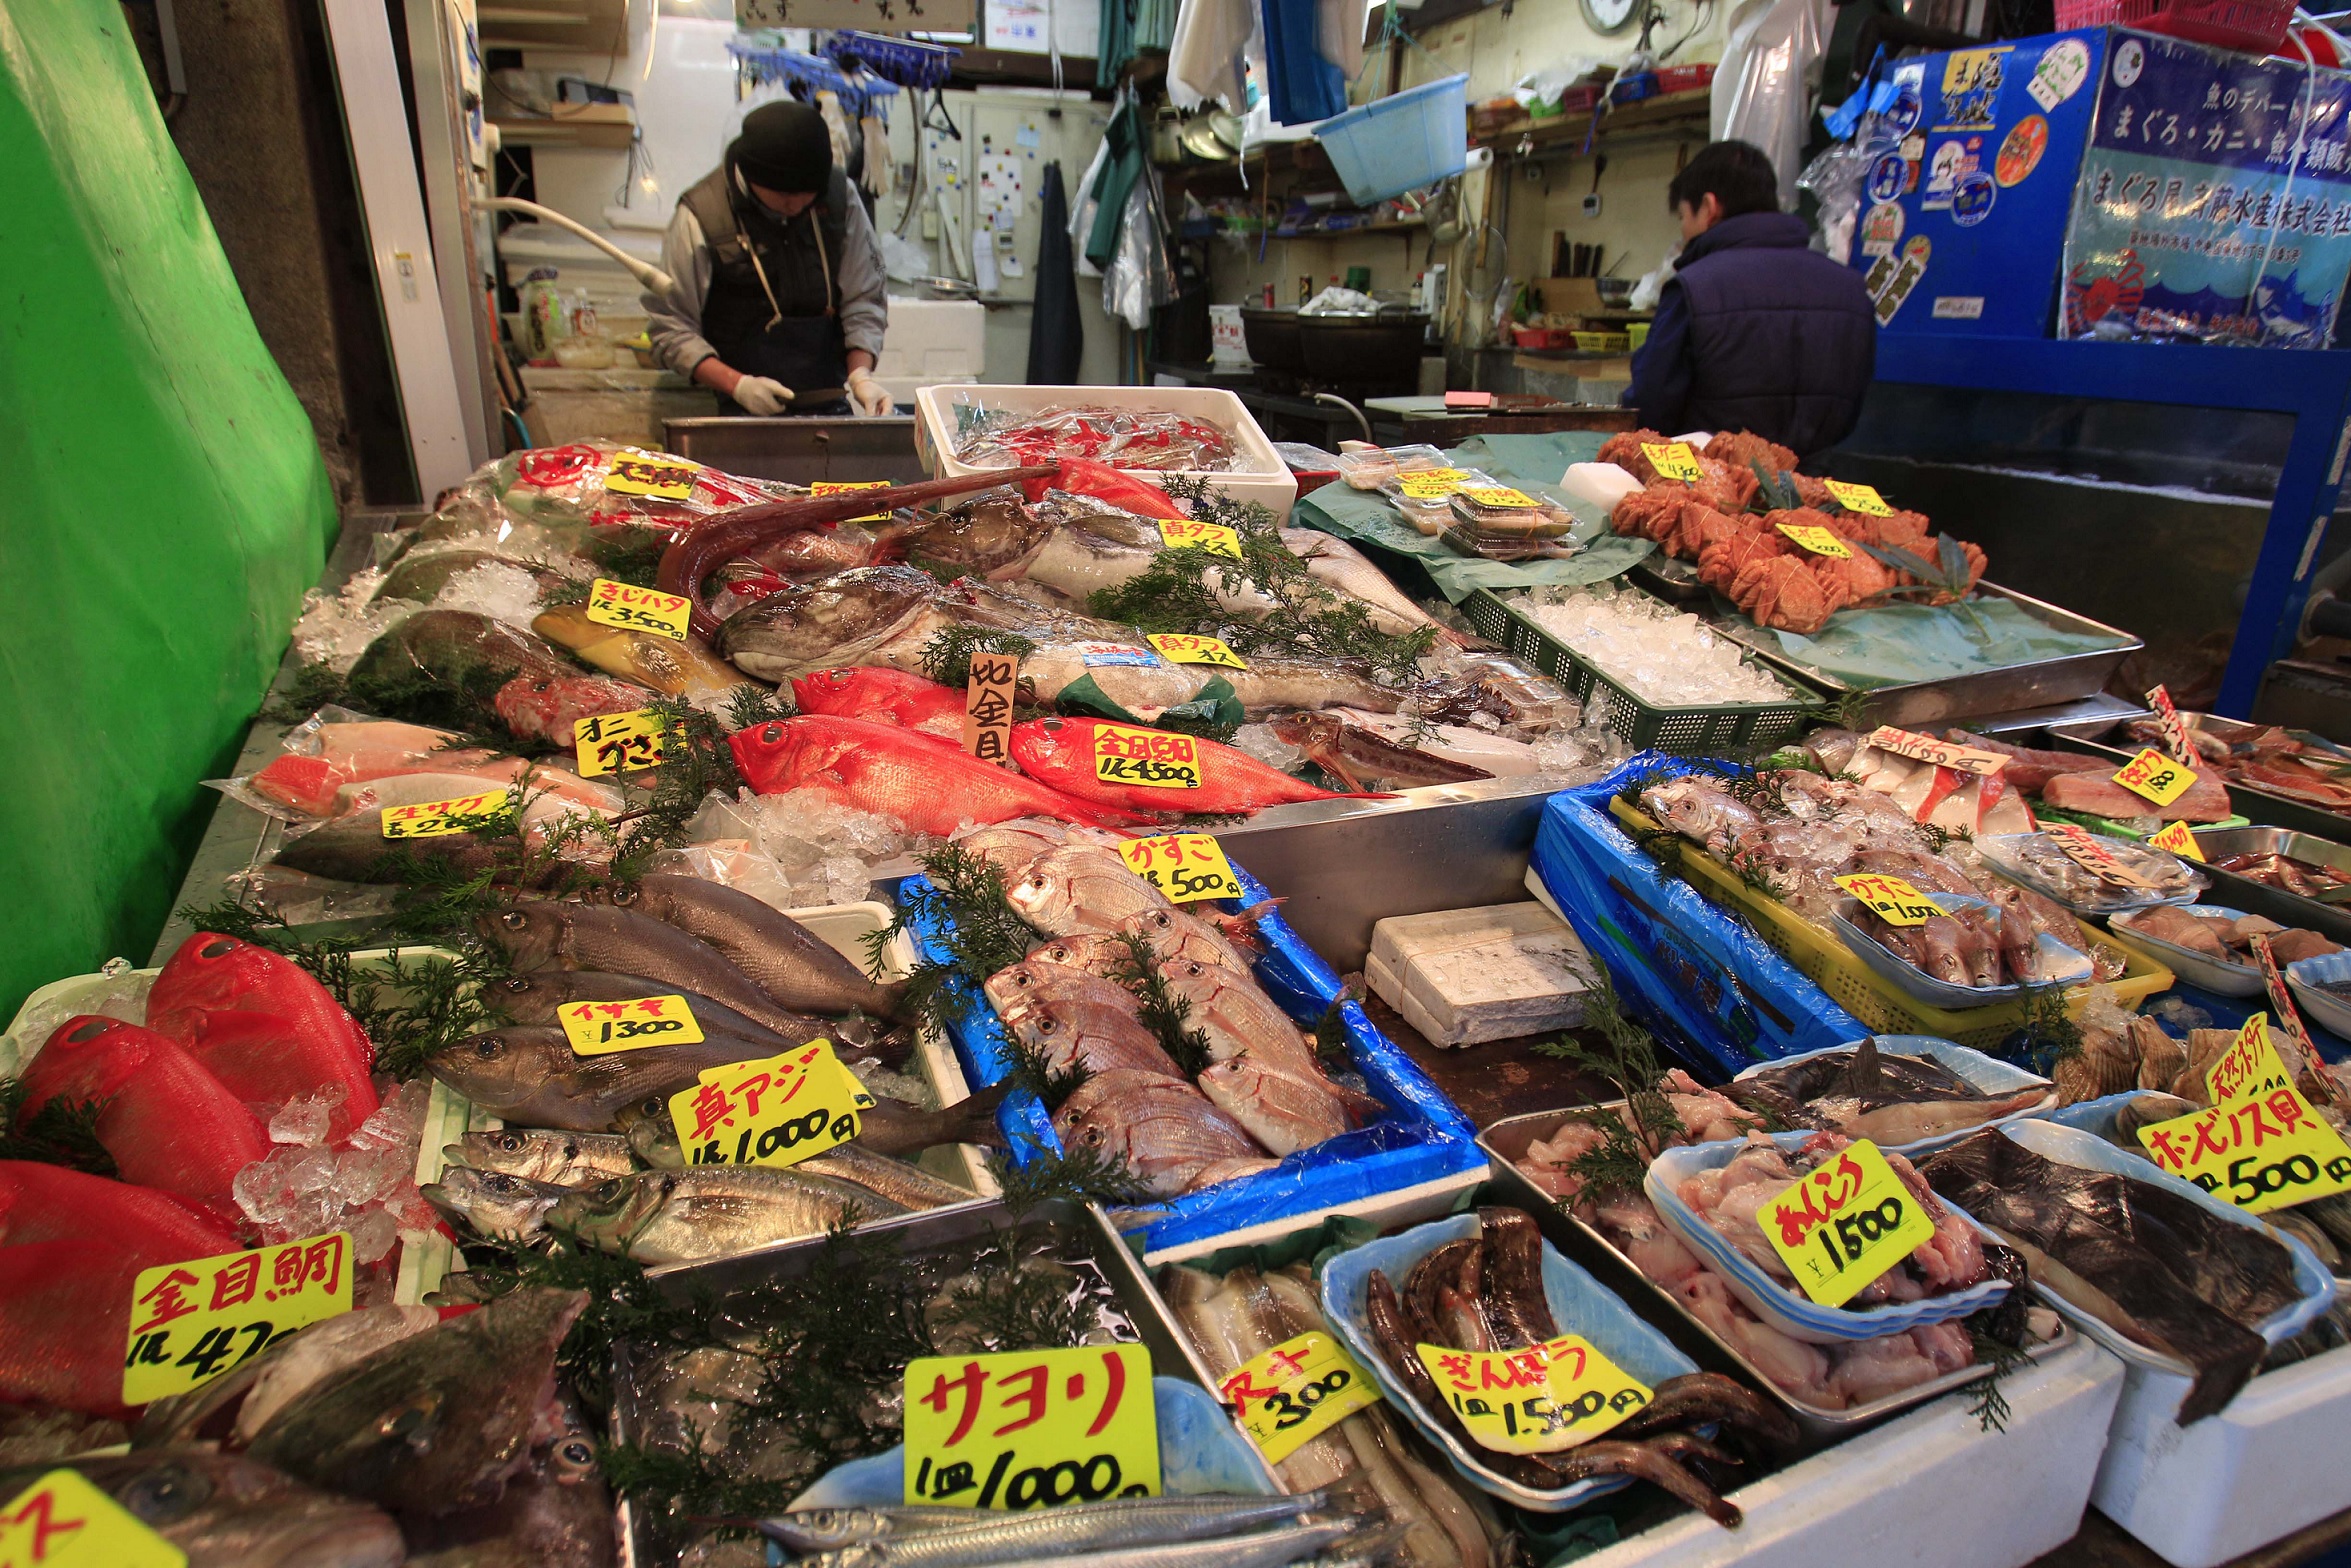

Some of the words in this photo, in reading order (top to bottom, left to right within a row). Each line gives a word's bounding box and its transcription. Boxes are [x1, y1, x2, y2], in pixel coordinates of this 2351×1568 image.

[1162, 521, 1225, 541] 真タラ
[599, 583, 686, 613] きじハタ
[1158, 635, 1220, 652] 真タラ
[969, 659, 1013, 768] 地金目
[1128, 835, 1214, 869] かすご
[571, 999, 666, 1021] イサキ
[689, 1047, 821, 1141] 真アジ
[133, 1234, 343, 1336] 金目鯛
[919, 1351, 1127, 1449] サヨリ
